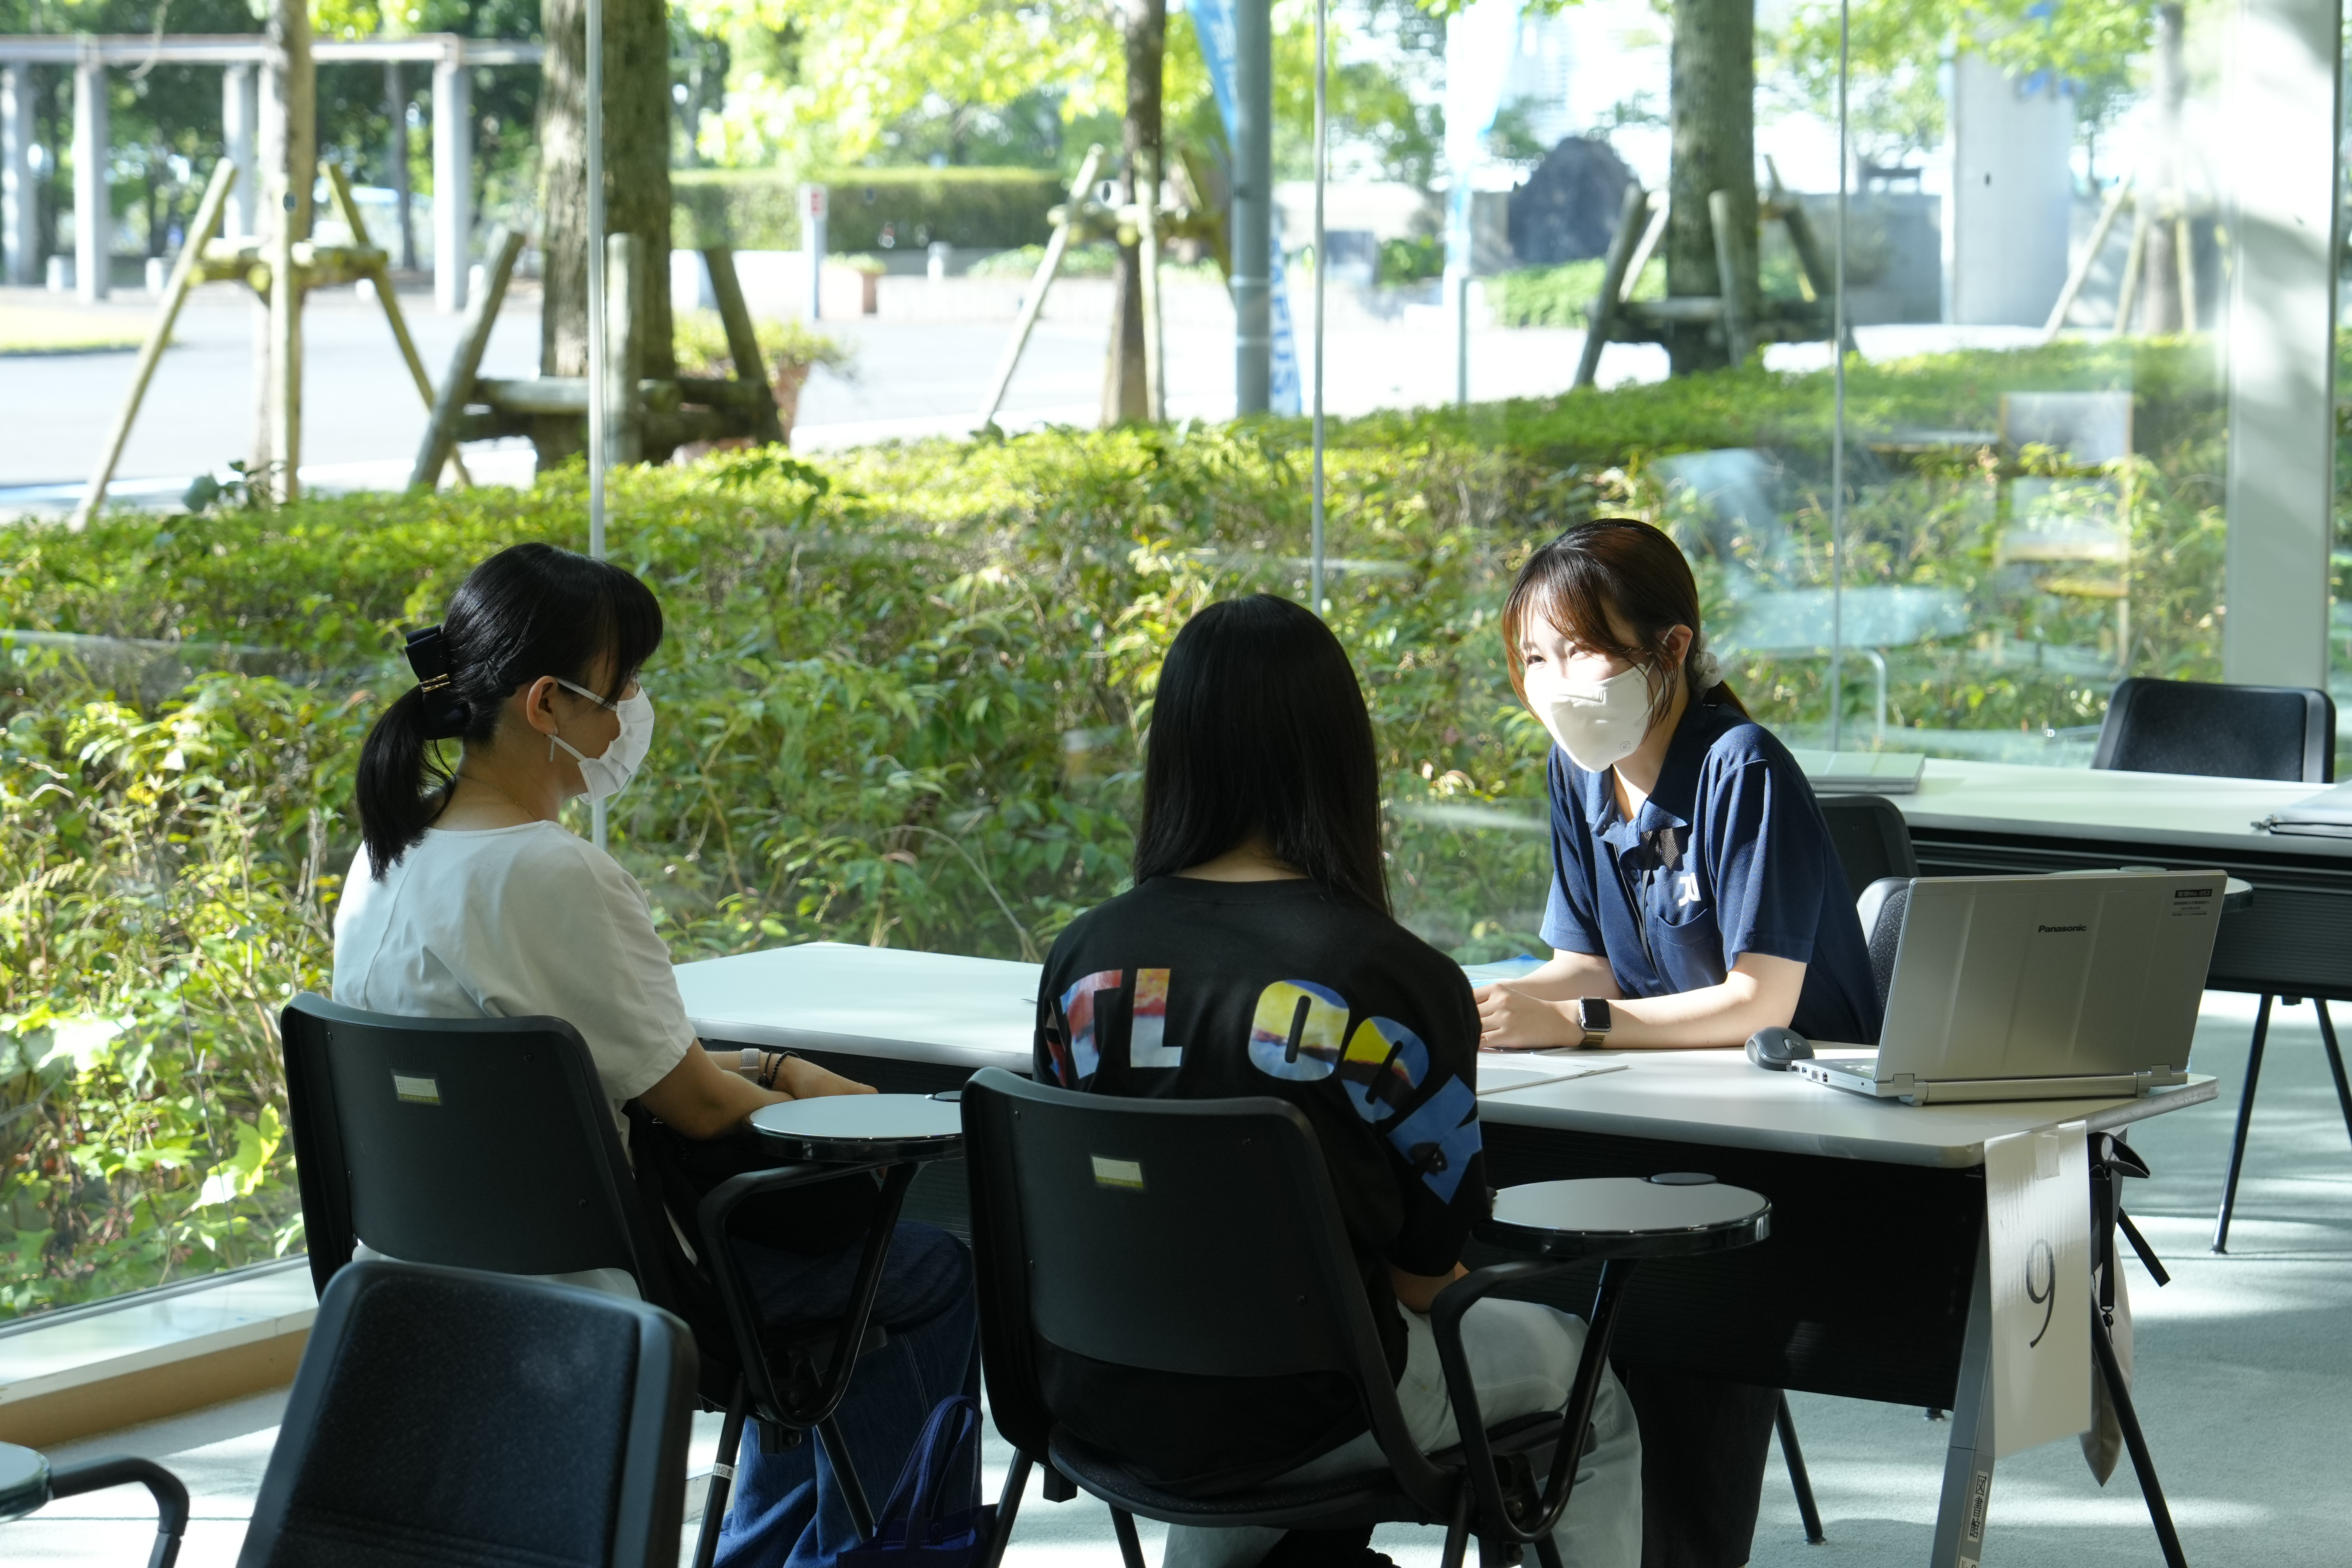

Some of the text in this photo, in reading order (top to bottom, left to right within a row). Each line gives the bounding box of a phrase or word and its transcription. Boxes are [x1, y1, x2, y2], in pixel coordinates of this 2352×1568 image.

[2038, 924, 2086, 933] Panasonic
[2026, 1238, 2055, 1349] 9
[1970, 1474, 1987, 1539] 図書館
